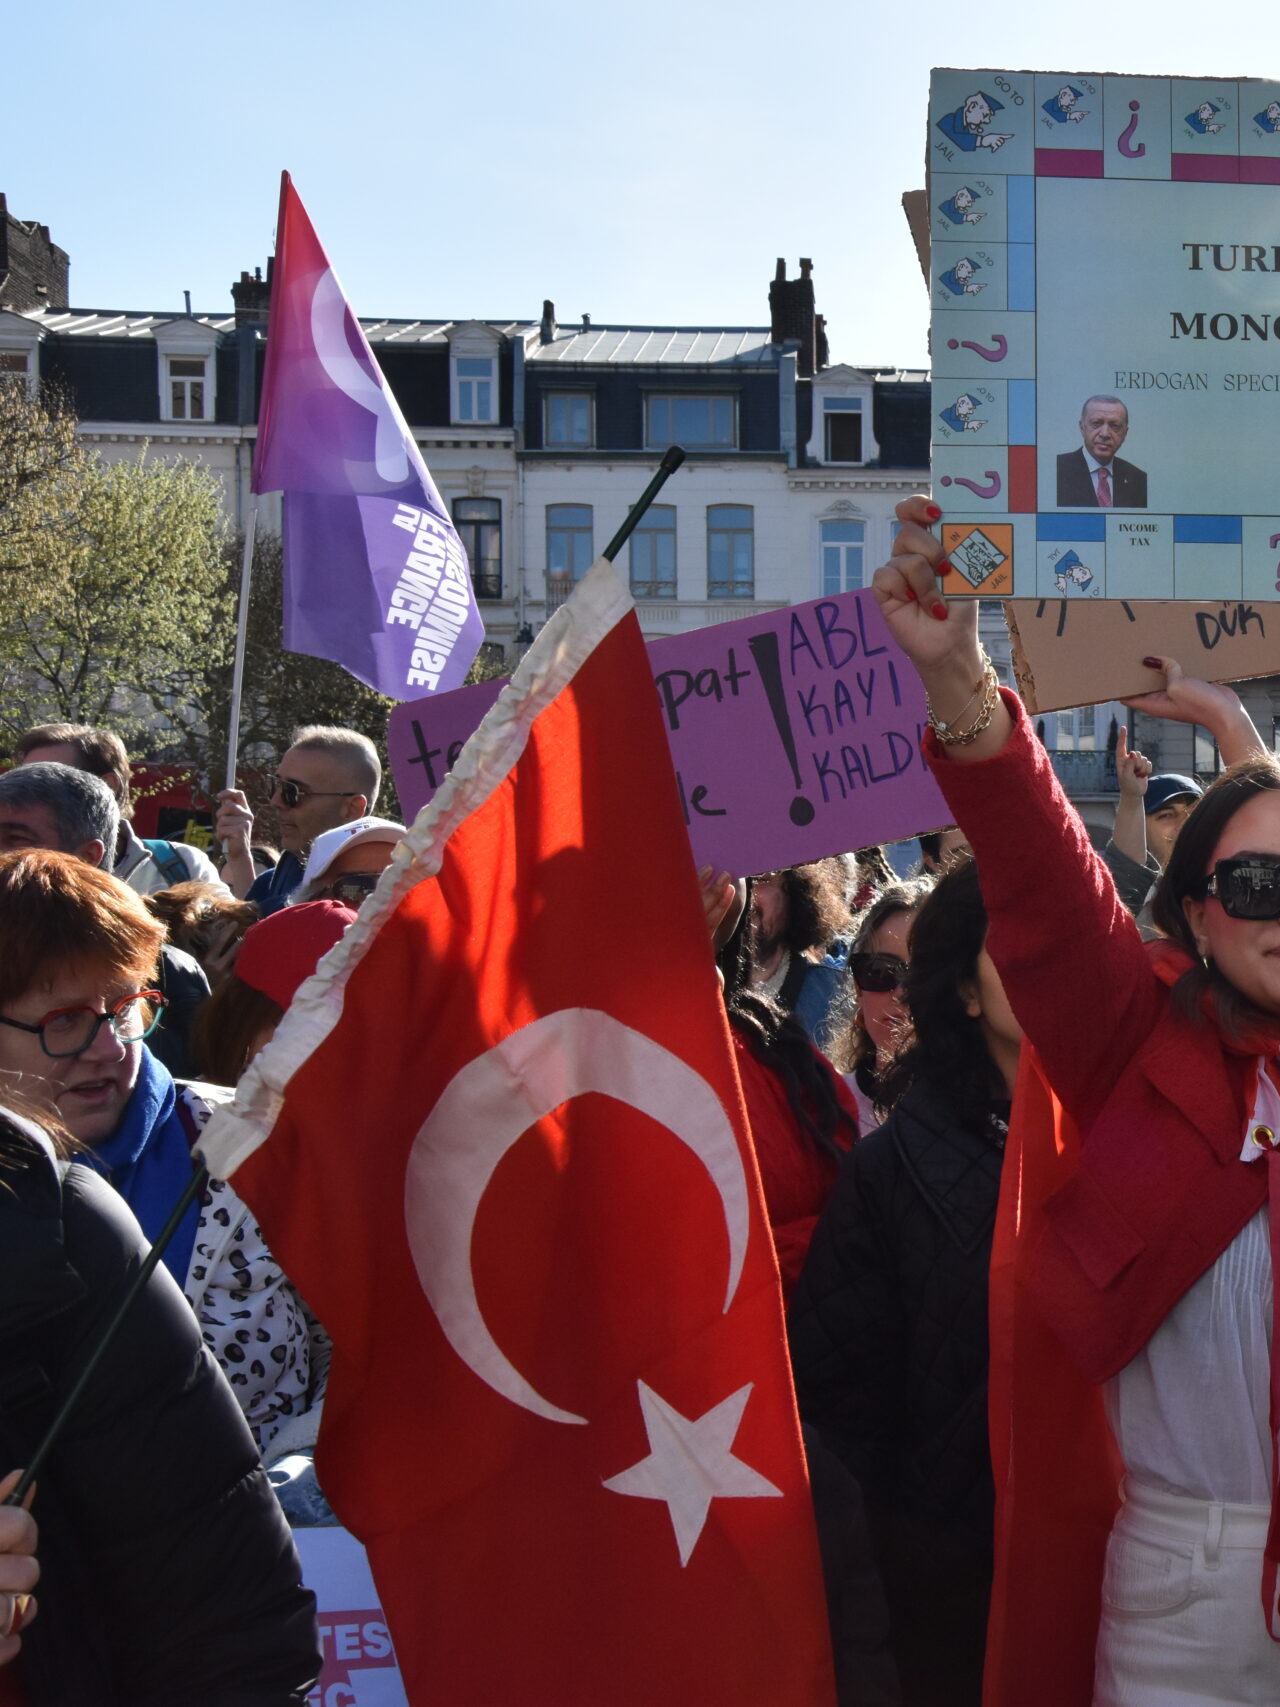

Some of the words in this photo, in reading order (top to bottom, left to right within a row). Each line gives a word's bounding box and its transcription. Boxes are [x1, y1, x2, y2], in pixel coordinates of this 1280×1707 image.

[1114, 371, 1209, 391] ERDOGAN
[950, 531, 961, 543] IN
[1118, 523, 1159, 534] INCOME
[1128, 537, 1151, 547] TAX
[991, 574, 1008, 590] JAIL
[790, 596, 888, 676] ABL
[656, 647, 750, 730] pat
[813, 721, 931, 803] KALDI
